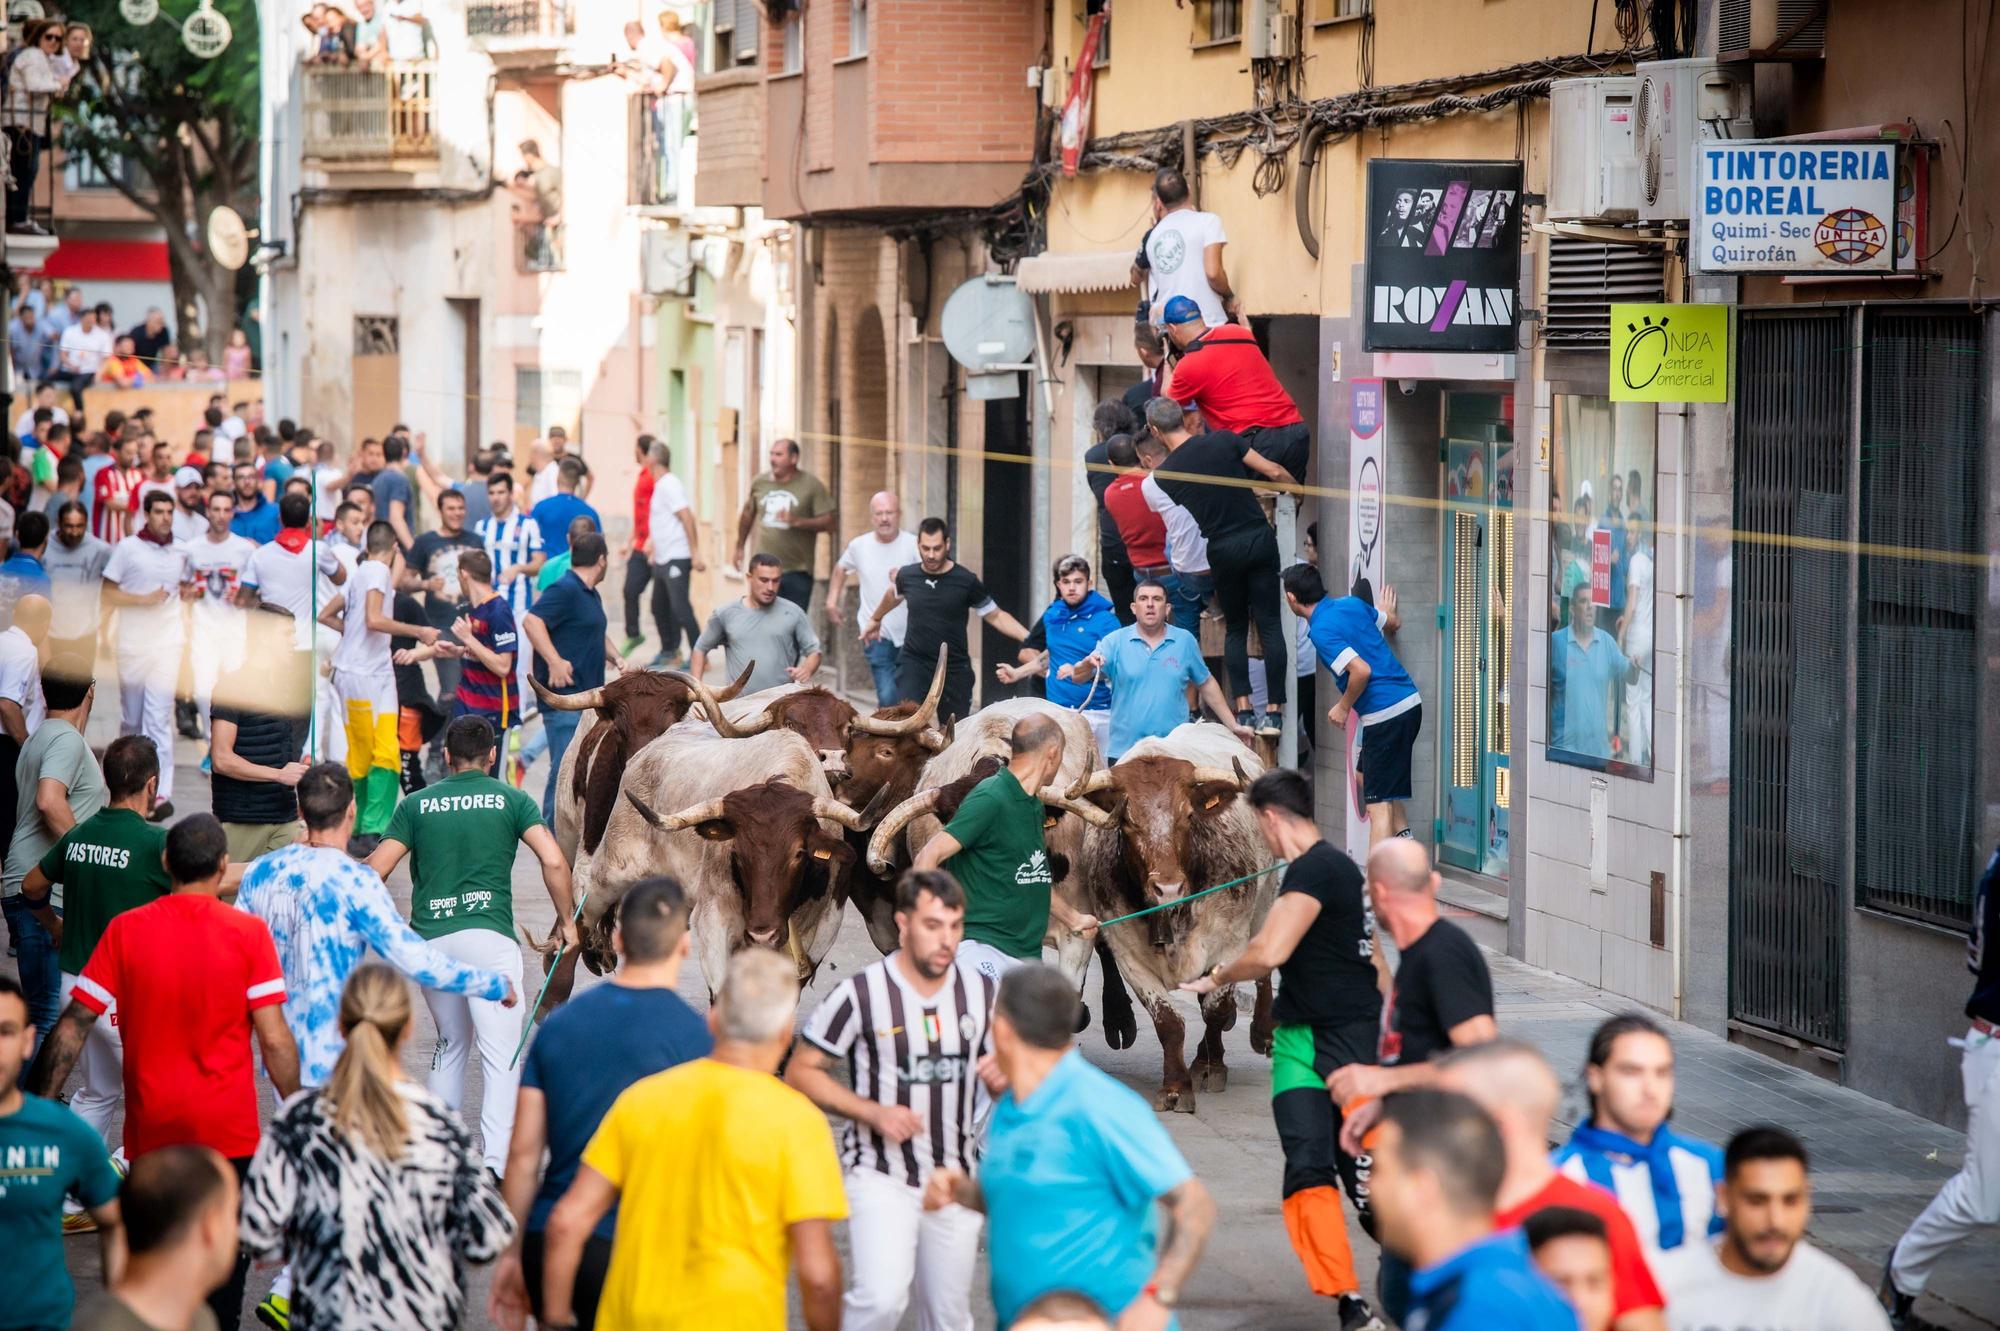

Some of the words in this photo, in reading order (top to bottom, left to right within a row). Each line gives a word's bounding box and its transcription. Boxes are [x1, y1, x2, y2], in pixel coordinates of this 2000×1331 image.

[1706, 151, 1890, 180] TINTORERIA
[1705, 186, 1825, 215] BOREAL
[1712, 245, 1797, 264] Quirofán
[420, 794, 505, 814] PASTORES
[65, 842, 131, 869] PASTORES
[429, 897, 458, 910] ESPORTS
[461, 890, 492, 904] LIZONDO
[896, 1057, 969, 1082] Jeep
